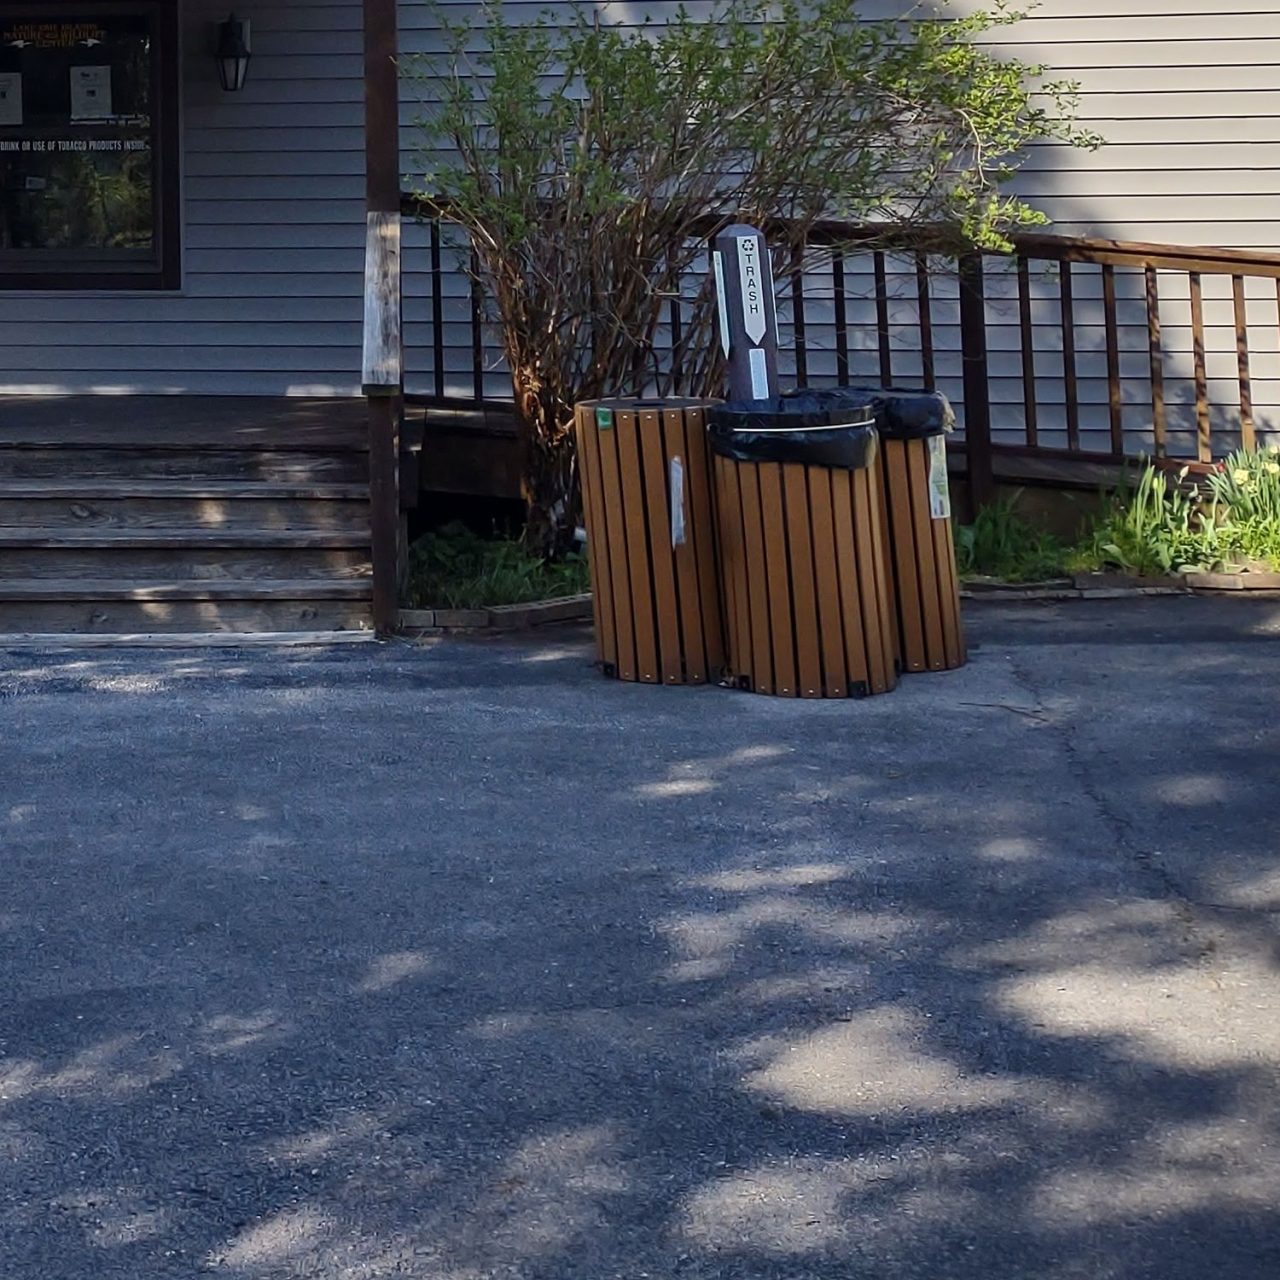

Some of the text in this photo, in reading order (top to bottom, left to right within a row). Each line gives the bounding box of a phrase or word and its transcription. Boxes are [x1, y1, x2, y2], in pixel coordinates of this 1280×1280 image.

[22, 140, 31, 151] OR
[32, 140, 46, 151] USE
[47, 140, 56, 151] OF
[57, 140, 87, 151] TOBACCO
[88, 140, 122, 151] PRODUCTS
[745, 254, 758, 314] TRASH
